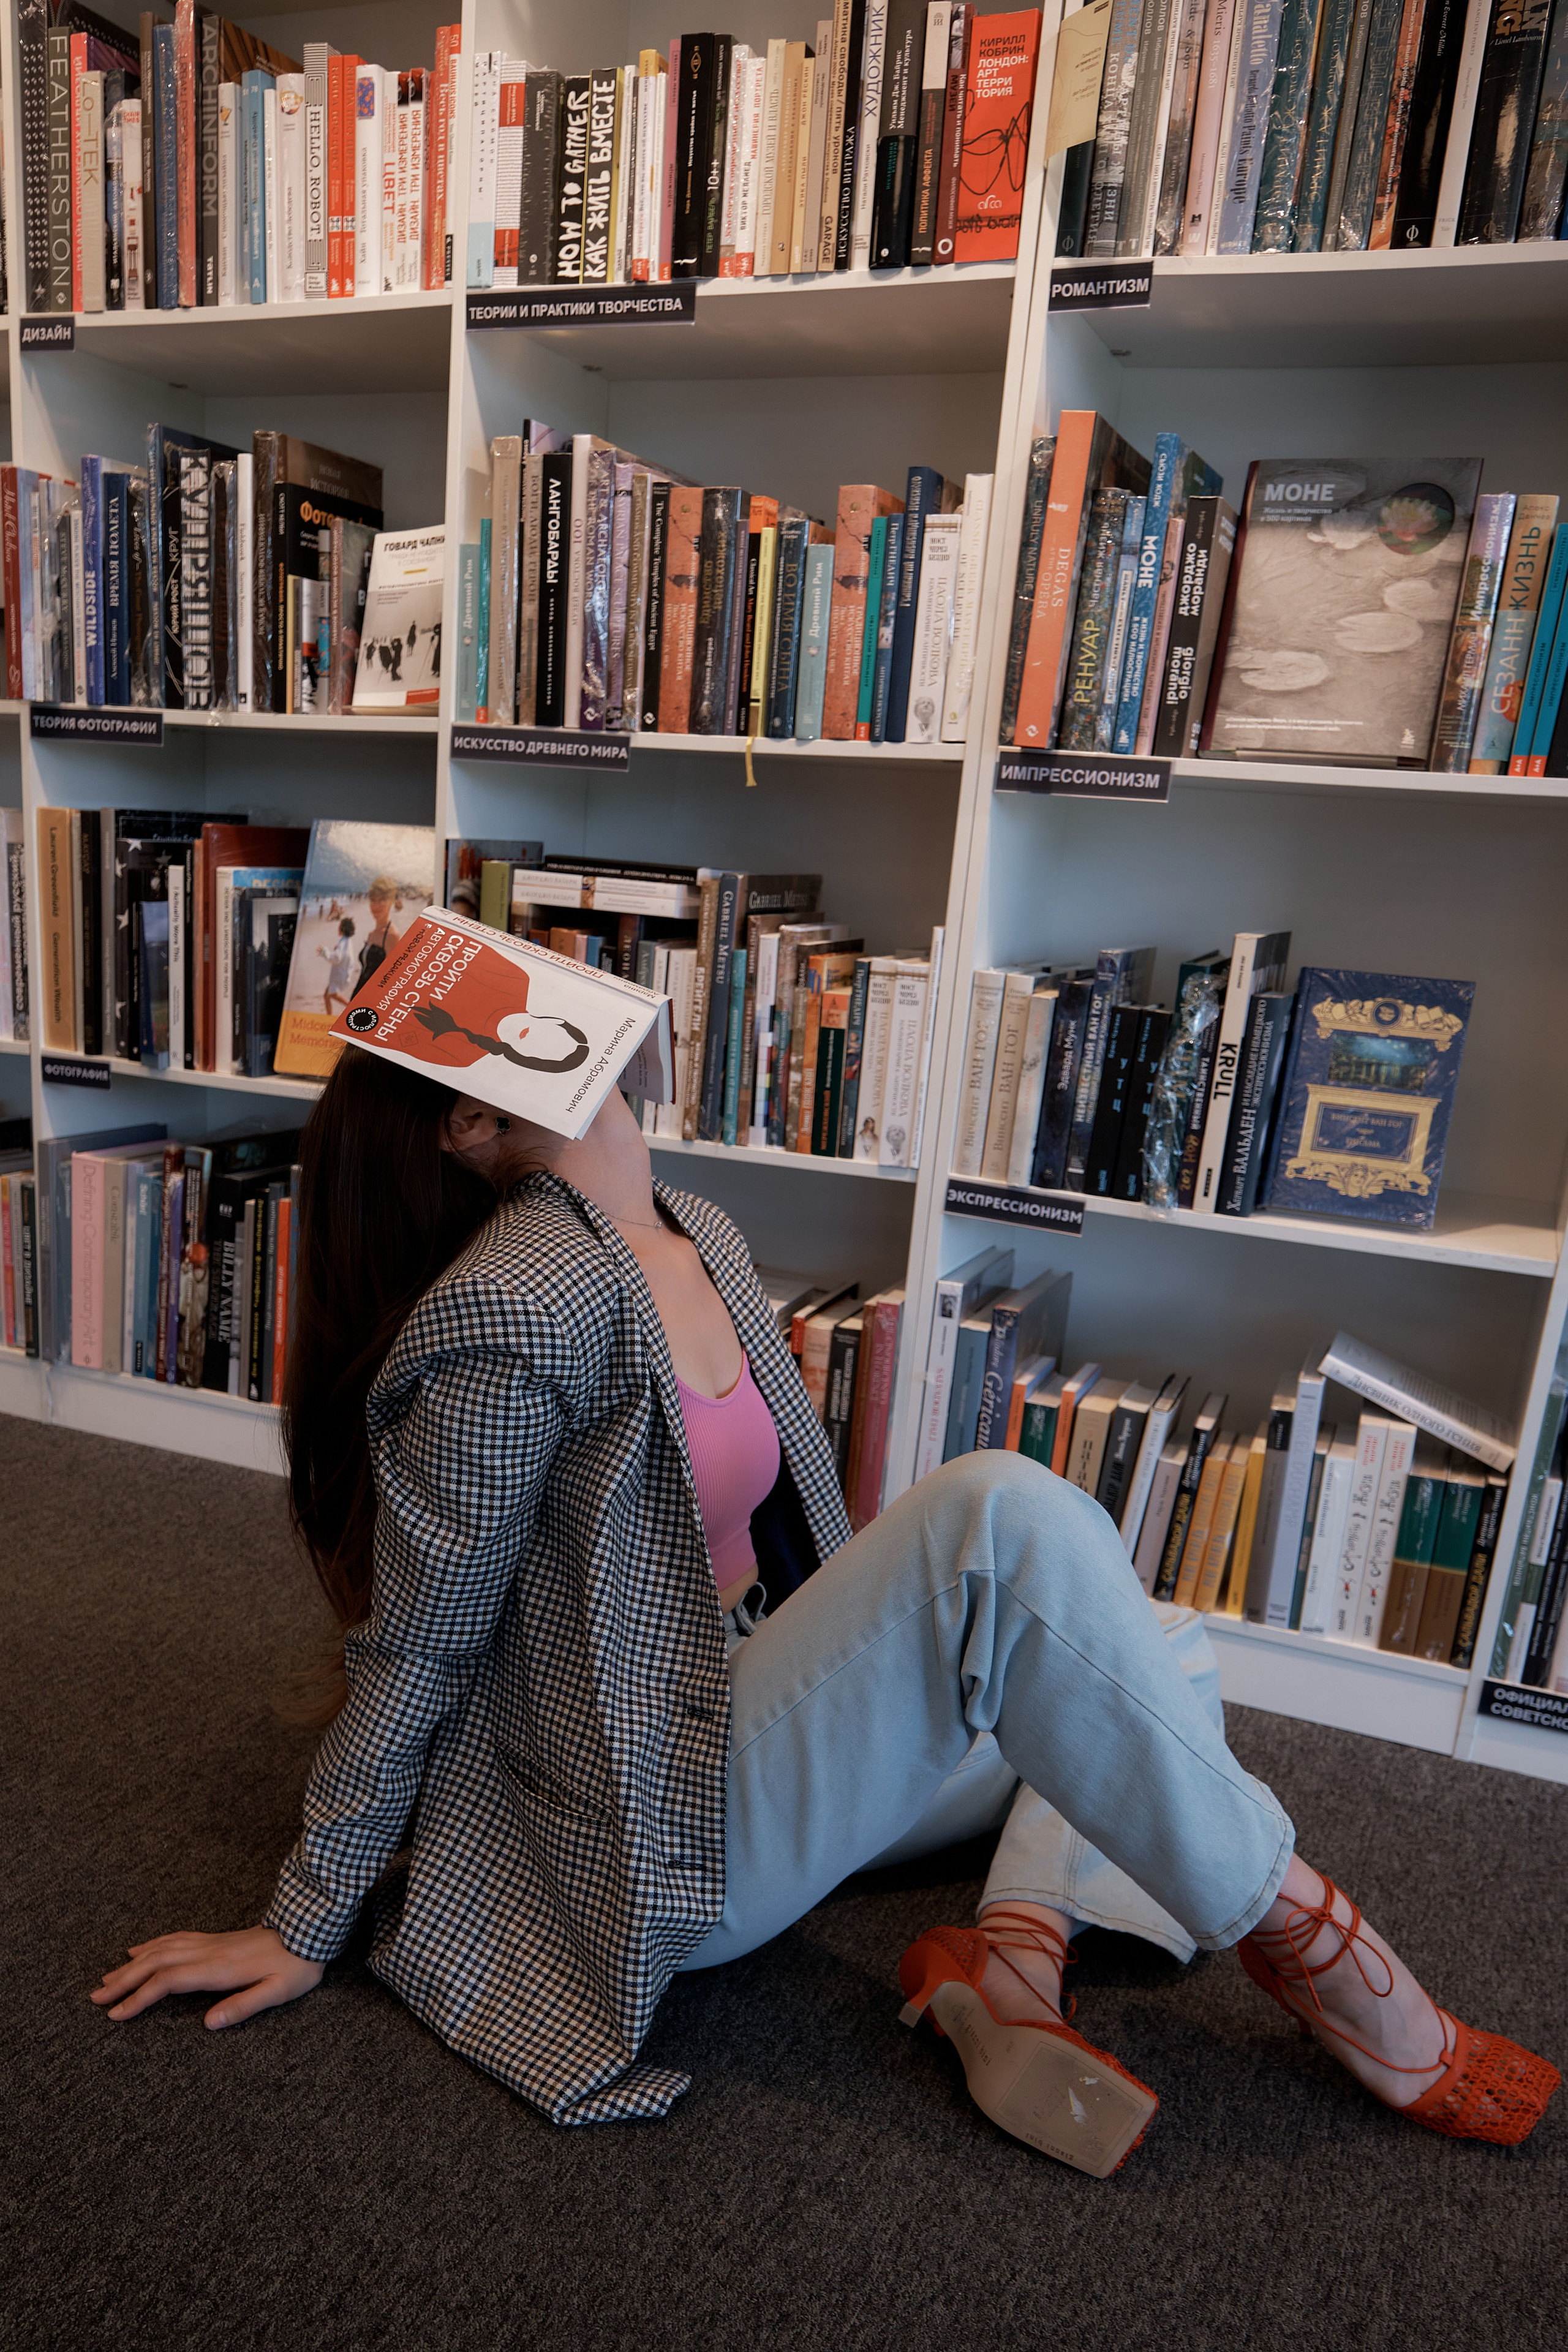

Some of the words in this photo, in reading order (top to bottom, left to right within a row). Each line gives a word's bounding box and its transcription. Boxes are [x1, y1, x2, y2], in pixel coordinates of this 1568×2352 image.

[1441, 6, 1450, 29] Everett
[450, 34, 459, 47] 50
[979, 45, 1025, 58] КОБРИН
[980, 35, 1025, 47] КИРИЛЛ
[1183, 47, 1194, 70] Son
[1436, 30, 1446, 56] Millais
[449, 59, 458, 95] BAUHAUS
[864, 5, 884, 117] ХУДОЖНИК
[897, 76, 908, 129] Менеджмент
[903, 29, 912, 66] культура
[977, 69, 997, 78] АРТ
[978, 55, 1029, 68] ЛОНДОН:
[439, 83, 448, 115] Весь
[958, 74, 967, 89] Как
[976, 77, 1012, 88] ТЕРРИ
[976, 86, 1012, 98] ТОРИЯ
[203, 23, 218, 217] ARCHINFORM
[589, 80, 615, 164] ВМЕСТЕ
[769, 89, 779, 121] ВЛАСТЬ
[889, 99, 899, 130] Уильям
[956, 91, 965, 119] читать
[309, 110, 321, 172] HELLO,
[398, 113, 407, 173] ИЗМЕРЕНИЯ
[410, 110, 419, 170] ИЗМЕРЕНИЯ
[564, 91, 590, 174] GATHER
[728, 115, 739, 183] современного
[742, 162, 752, 197] МЕЛАМЕД
[753, 67, 763, 107] ПОРТРЕТА
[765, 135, 776, 163] МУЗЕЙ
[952, 127, 962, 167] понимать
[1239, 124, 1256, 154] Paints
[50, 36, 70, 286] FEATHERSTON
[707, 159, 720, 191] 10++
[832, 135, 840, 175] уроков
[843, 126, 855, 184] ВИТРАЖА
[922, 149, 933, 186] АФФЕКТА
[383, 162, 396, 214] ЦВЕТ
[398, 177, 407, 196] ТРИ
[410, 174, 419, 193] ТРИ
[436, 155, 445, 200] цветах
[761, 167, 773, 215] ГОРОДСКОЙ
[1231, 157, 1254, 204] Europe
[561, 182, 582, 214] TO
[586, 170, 611, 232] ЖИТЬ
[706, 197, 716, 230] ВАЙБЕЛЬ
[919, 189, 930, 233] ПОЛИТИКА
[821, 216, 833, 263] GARAGE
[837, 187, 850, 257] ИСКУССТВО
[557, 221, 582, 278] HOW
[584, 236, 607, 279] КАК
[1051, 277, 1150, 298] РОМАНТИЗМ
[469, 304, 516, 320] ТЕОРИИ
[519, 304, 529, 318] И
[530, 301, 595, 317] ПРАКТИКИ
[598, 297, 683, 314] ТВОРЧЕСТВА
[22, 326, 72, 342] ДИЗАЙН
[655, 500, 664, 516] The
[1264, 483, 1335, 502] МОНЕ
[109, 497, 119, 556] ПОЛЕТА
[168, 527, 179, 562] КРУГ
[384, 541, 418, 552] ГОВАРД
[546, 478, 561, 583] ЛАНГОБАРДЫ
[586, 517, 597, 566] ROMAN
[652, 518, 663, 555] Complete
[573, 550, 581, 588] ВОСТОКА
[650, 557, 660, 587] Temples
[748, 559, 757, 583] Classical
[785, 563, 798, 587] ВО
[813, 563, 823, 584] Рим
[886, 546, 899, 586] ГНЕДИЧ
[1023, 546, 1036, 590] NATURE
[1052, 548, 1071, 608] DEGAS
[1137, 535, 1158, 588] МОНЕ
[109, 560, 119, 606] ВРЕМЯ
[652, 589, 659, 598] of
[934, 577, 948, 622] ПАОЛА
[85, 570, 97, 647] WILDSIDE
[650, 599, 659, 627] Ancient
[781, 592, 796, 633] ИМЯ
[809, 589, 821, 638] Древний
[1491, 618, 1525, 714] СЕЗАНН
[1508, 527, 1540, 609] ЖИЗНЬ
[649, 628, 657, 651] Egypt
[1139, 617, 1149, 642] ЖИЗНЬ
[777, 638, 793, 692] СЫНА
[929, 627, 943, 687] ВОЛКОВА
[1074, 619, 1101, 703] РЕНУАР
[1131, 650, 1146, 697] ТВОРЧЕСТВО
[1166, 646, 1183, 705] morandi
[1176, 646, 1196, 699] giorgio
[32, 715, 75, 729] ТЕОРИЯ
[78, 718, 157, 734] ФОТОГРАФИИ
[454, 737, 524, 751] ИСКУССТВО
[526, 742, 589, 756] ДРЕВНЕГО
[591, 745, 628, 759] МИРА
[1001, 764, 1161, 788] ИМПРЕССИОНИЗМ
[453, 917, 496, 937] СТЕНЫ
[719, 890, 734, 941] GABRIEL
[415, 935, 464, 988] СКВОЗЬ
[499, 934, 548, 959] СКВОЗЬ
[377, 928, 445, 1011] АВТОБИОГРАФИЯ
[377, 952, 407, 987] РЕДАКЦИИ
[430, 941, 483, 1000] ПРОЙТИ
[549, 956, 603, 979] ПРОЙТИ
[375, 992, 420, 1042] СТЕНЫ
[692, 967, 705, 1031] БРЕЙГЕЛИ
[1091, 993, 1103, 1015] ГОГ
[347, 1008, 377, 1031] ИЛЛЮСТРАЦИЯМИ
[605, 1017, 636, 1056] Марина
[1004, 1024, 1020, 1055] ГОГ
[1063, 1019, 1077, 1049] Мунк
[1088, 1017, 1100, 1040] ВАН
[905, 1020, 918, 1060] ПАОЛА
[44, 1063, 110, 1081] ФОТОГРАФИЯ
[565, 1057, 609, 1113] Абрамович
[872, 1056, 886, 1108] ВОЛКОВА
[899, 1064, 914, 1117] ВОЛКОВА
[970, 1057, 984, 1089] ВАН
[998, 1061, 1014, 1093] ВАН
[1057, 1051, 1073, 1091] Эдвард
[1074, 1042, 1096, 1123] НЕИЗВЕСТНЫЙ
[1213, 1042, 1238, 1101] KRULL
[1232, 1109, 1256, 1174] ВАЛЬДЕН
[80, 1165, 97, 1221] Defining
[946, 1188, 1082, 1224] ЭКСПРЕССИОНИЗМ
[80, 1223, 97, 1324] Contemporary
[221, 1240, 235, 1293] BILLY
[82, 1326, 97, 1346] Art
[217, 1295, 233, 1343] NAME
[1348, 1373, 1403, 1411] Дневник
[1401, 1402, 1444, 1434] одного
[1445, 1427, 1481, 1453] гения
[1163, 1524, 1183, 1581] САЛЬВАДОР
[1460, 1586, 1479, 1648] САЛЬВАДОР
[1472, 1553, 1487, 1585] ДАЛИ
[1025, 2133, 1043, 2146] bini
[1046, 2143, 1074, 2162] gianni
